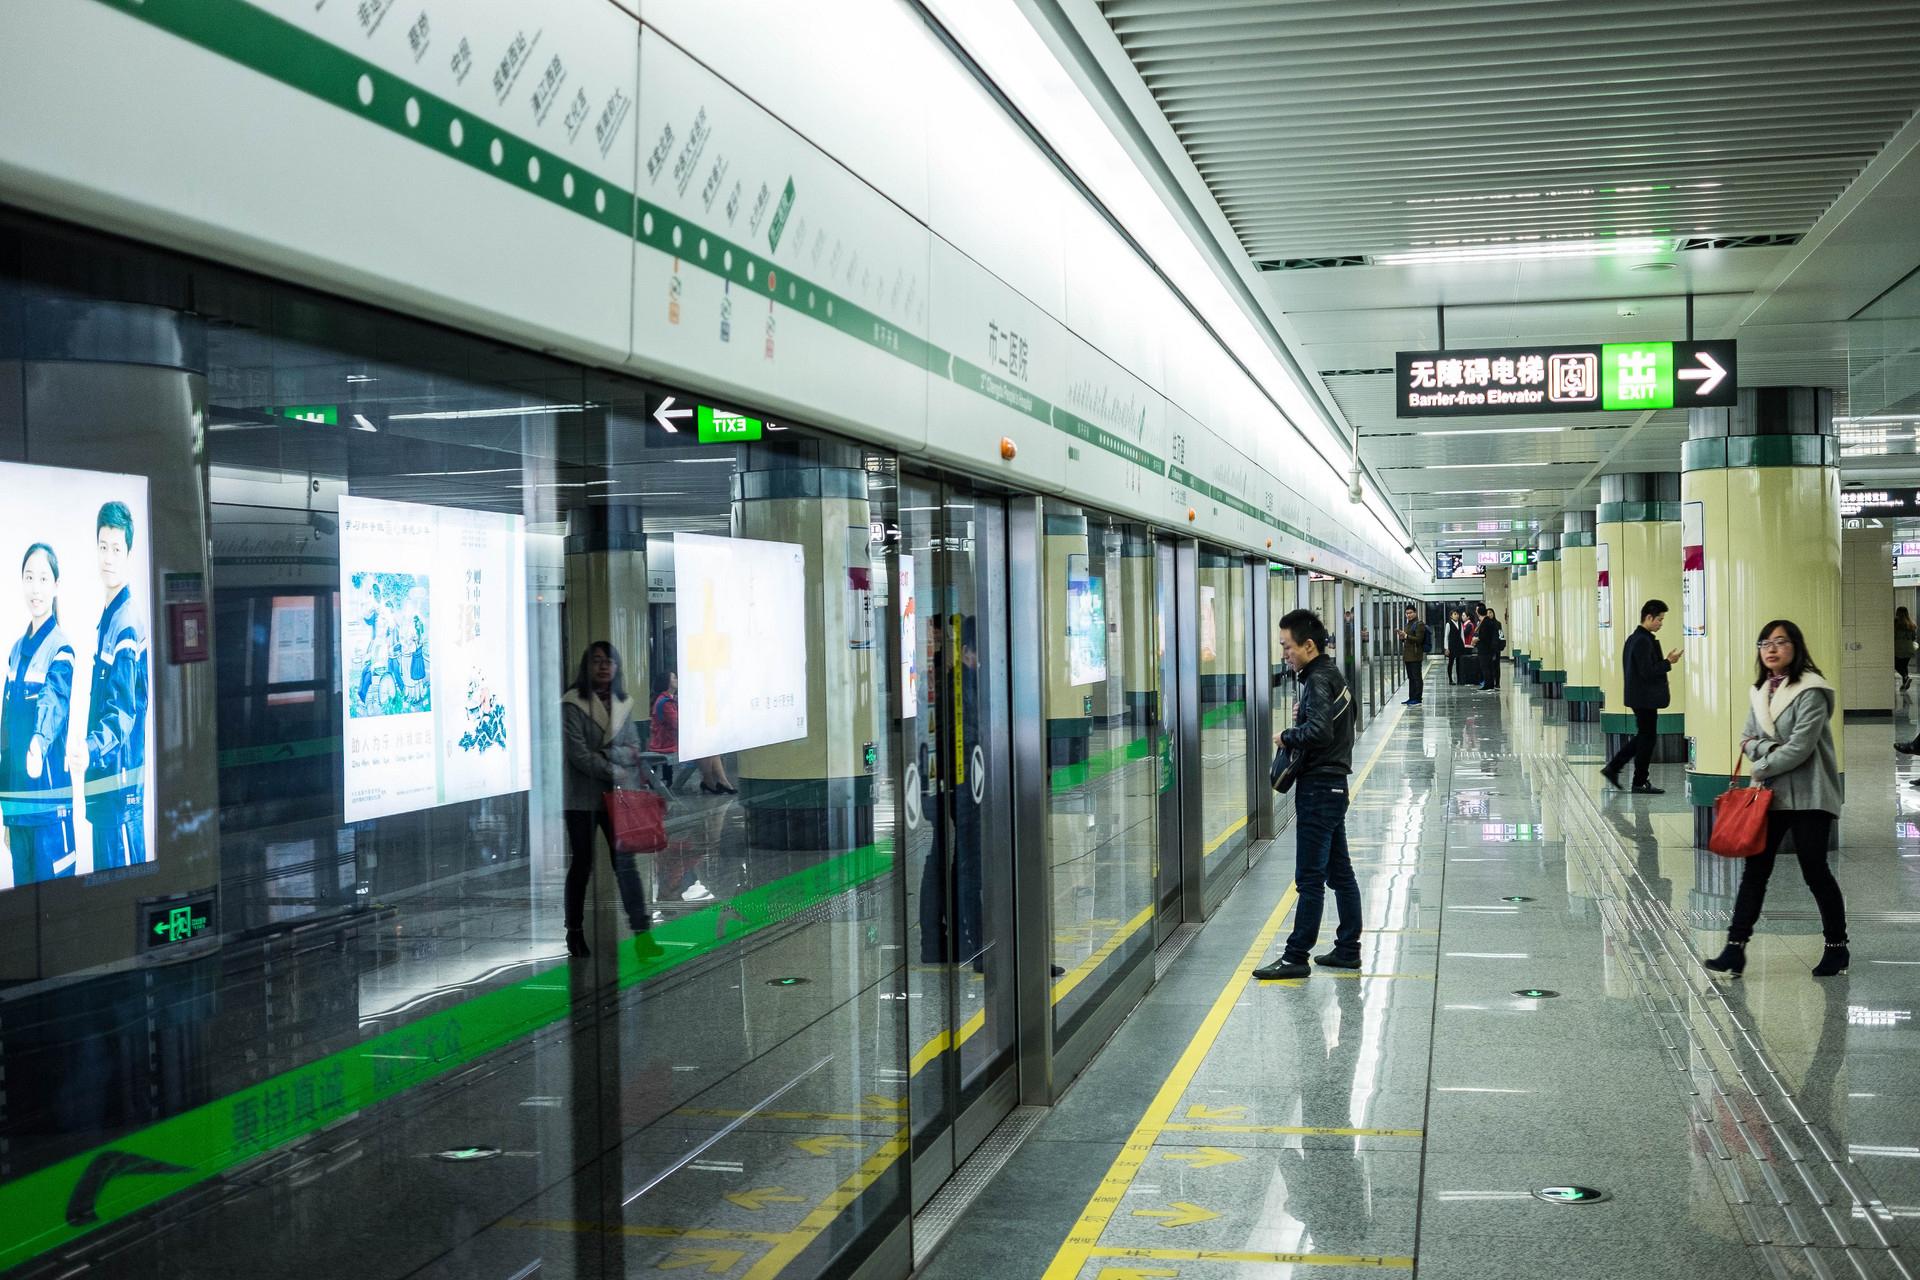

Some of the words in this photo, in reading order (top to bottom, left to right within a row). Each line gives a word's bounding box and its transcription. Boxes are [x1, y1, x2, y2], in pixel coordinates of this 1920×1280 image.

[988, 319, 1029, 383] 市二医院
[1409, 354, 1545, 389] 无障碍电梯
[1618, 350, 1657, 384] 出
[1408, 391, 1485, 408] Barrier-free
[1487, 388, 1545, 406] Elevator
[1617, 383, 1657, 401] EXIT
